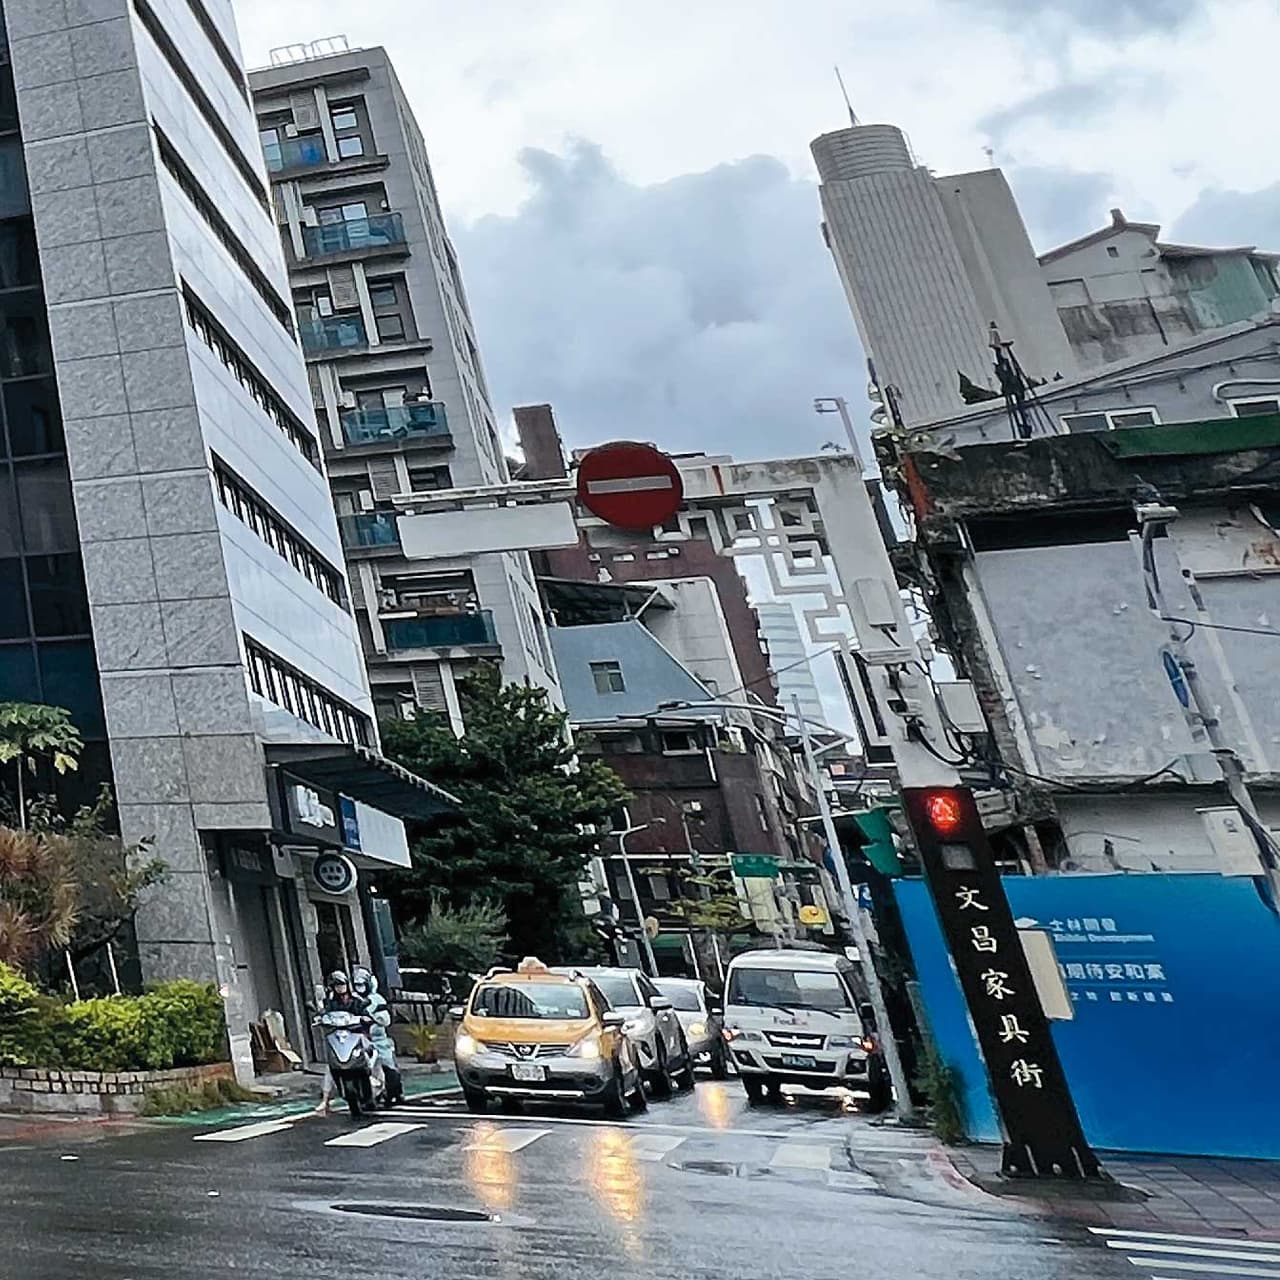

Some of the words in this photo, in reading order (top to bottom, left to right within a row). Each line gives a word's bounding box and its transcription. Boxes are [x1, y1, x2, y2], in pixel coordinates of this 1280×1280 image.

[955, 875, 1044, 1089] 文昌家具街
